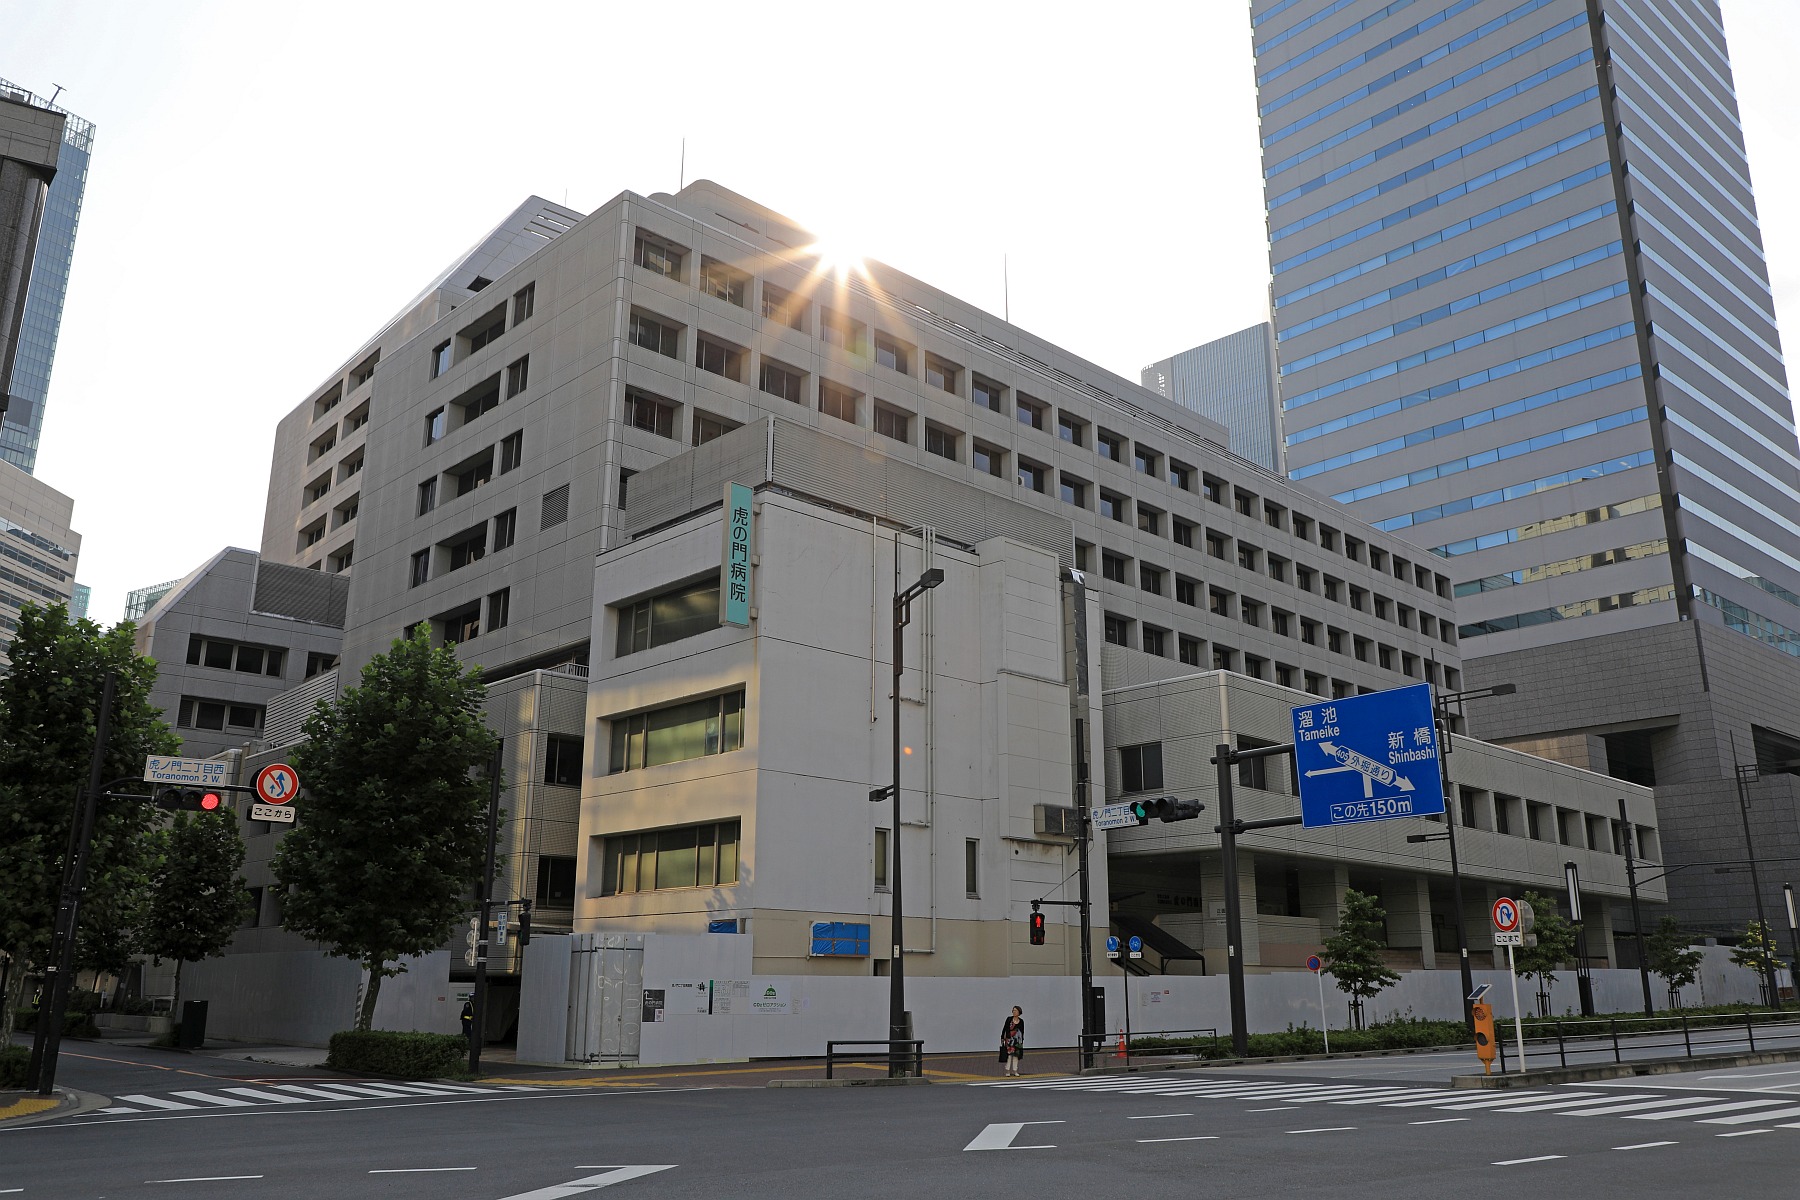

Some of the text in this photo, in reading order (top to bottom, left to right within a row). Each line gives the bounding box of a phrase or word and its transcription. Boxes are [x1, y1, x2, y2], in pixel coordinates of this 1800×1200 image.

[730, 506, 749, 603] 虎の門病院
[1298, 725, 1340, 742] Tameike
[1336, 748, 1350, 762] 405
[1388, 745, 1436, 765] Shinbashi
[149, 760, 225, 775] 虎ノ門二丁目西
[1350, 755, 1391, 781] 外堀通り
[151, 771, 199, 782] Toranomon
[254, 807, 292, 819] ここから
[1092, 805, 1133, 820] 虎ノ門二丁目
[1095, 818, 1124, 827] Toranomon
[1496, 935, 1520, 943] ここまで
